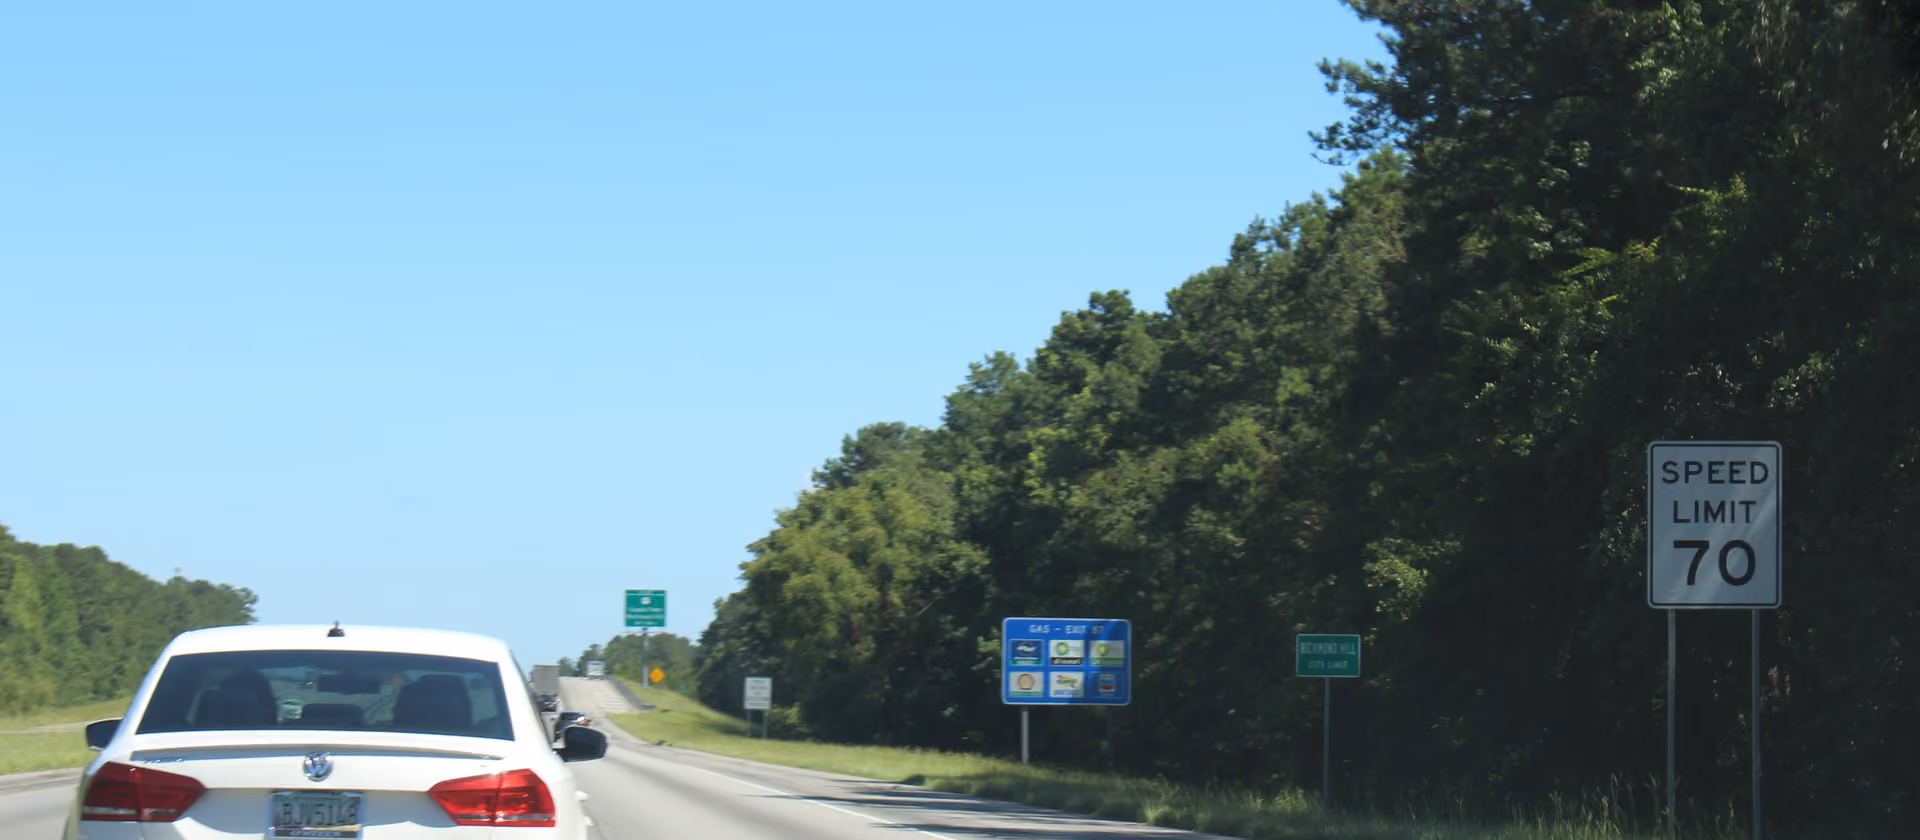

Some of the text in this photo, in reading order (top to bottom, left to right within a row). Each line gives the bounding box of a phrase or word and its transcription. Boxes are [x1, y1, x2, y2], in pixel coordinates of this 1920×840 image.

[1662, 460, 1769, 484] SPEED
[1673, 500, 1757, 524] LIMIT
[1673, 539, 1756, 587] 70
[1028, 624, 1050, 634] GAS
[1065, 625, 1087, 634] EXIT
[1309, 660, 1349, 669] CITY LIMIT
